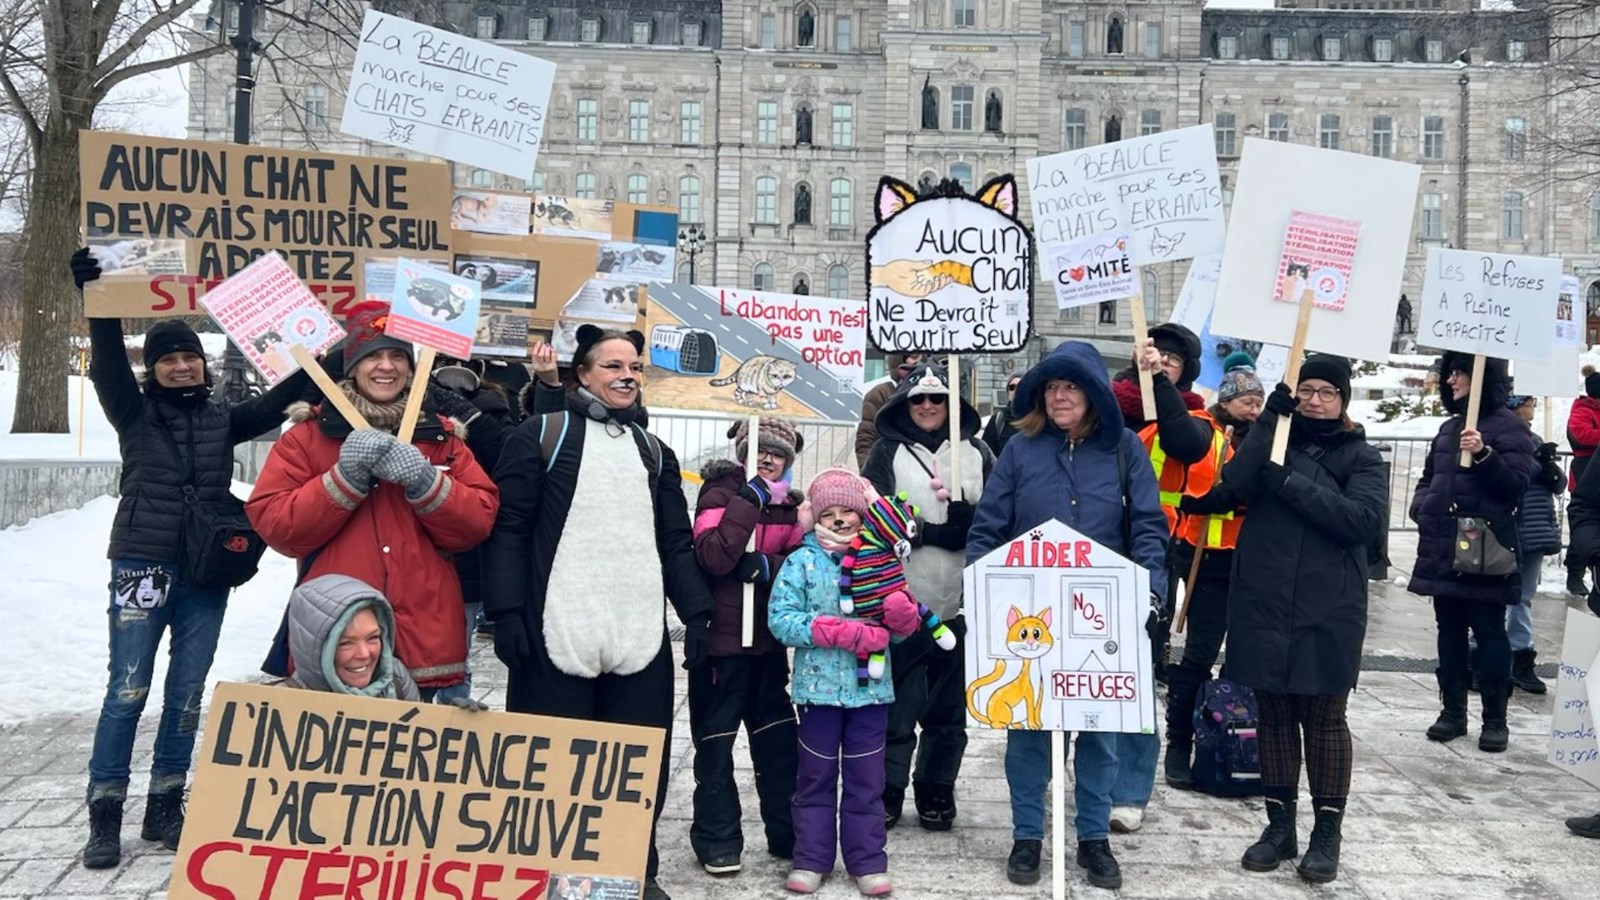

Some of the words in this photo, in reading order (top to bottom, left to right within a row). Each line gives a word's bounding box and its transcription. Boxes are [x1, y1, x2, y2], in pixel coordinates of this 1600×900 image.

[363, 18, 402, 55] La
[413, 30, 518, 80] BEAUCE
[354, 82, 427, 118] CHATS
[441, 104, 540, 146] ERRANTS
[362, 61, 445, 93] marche
[503, 97, 542, 121] ses
[99, 144, 227, 196] AUCUN
[243, 154, 335, 204] CHAT
[350, 164, 409, 210] NE
[1033, 163, 1068, 190] La
[1075, 140, 1180, 180] BEAUCE
[1037, 187, 1106, 216] marche
[1167, 168, 1207, 186] ses
[1039, 208, 1118, 244] CHATS
[1131, 186, 1222, 225] ERRANTS
[87, 199, 256, 241] DEVRAIS
[263, 202, 373, 248] MOURIR
[378, 214, 449, 251] SEUL
[915, 218, 1021, 255] Aucun
[971, 248, 1031, 293] Chat
[1438, 253, 1465, 282] Les
[1480, 256, 1545, 291] Refuges
[720, 289, 822, 323] L'abandon
[829, 306, 867, 328] n'est
[875, 297, 905, 323] Ne
[916, 296, 999, 323] Devrait
[766, 323, 803, 345] pas
[813, 327, 844, 344] une
[878, 325, 960, 350] Mourir
[972, 321, 1022, 349] Seul
[801, 346, 864, 370] option
[1005, 539, 1093, 568] AIDER
[1073, 592, 1105, 630] NOS
[1052, 672, 1136, 700] REFUGES
[212, 701, 550, 792] L'INDIFFÉRENCE
[569, 738, 652, 809] TUE,
[233, 777, 445, 848] L'ACTION
[456, 792, 603, 862] SAUVE
[187, 841, 550, 900] STÉRILISEZ
